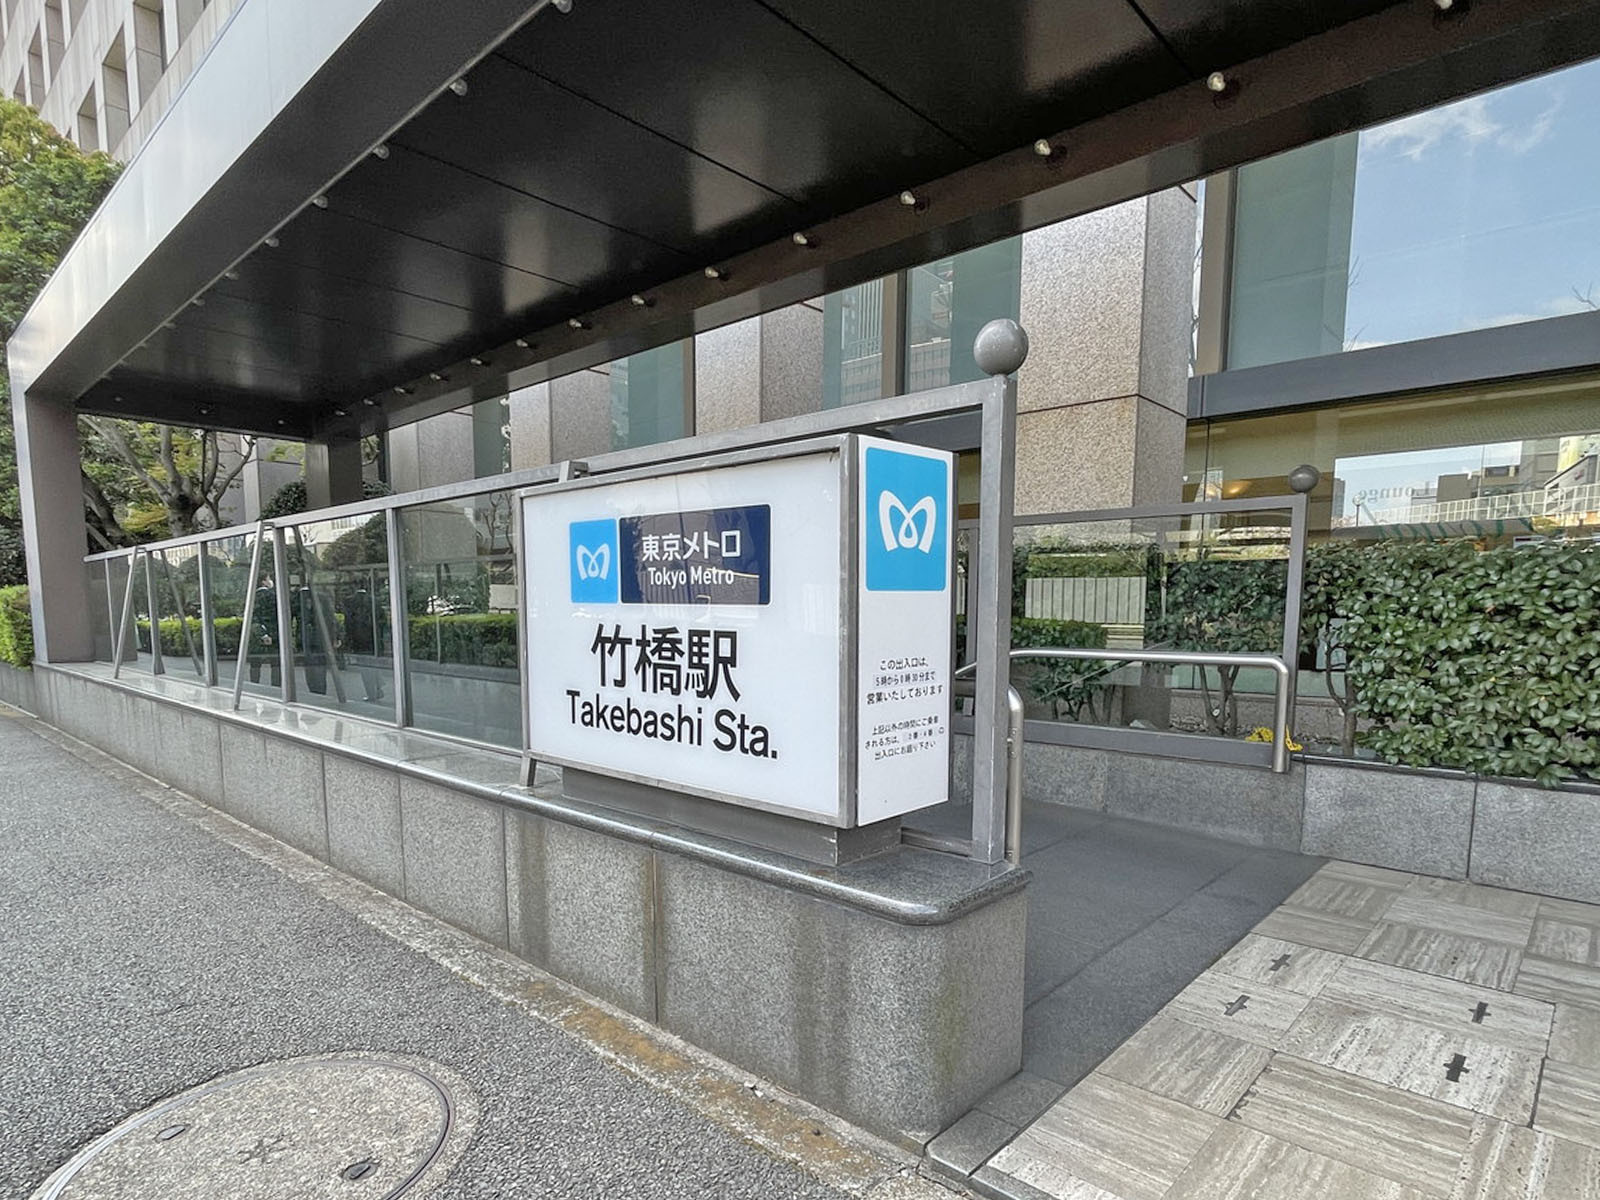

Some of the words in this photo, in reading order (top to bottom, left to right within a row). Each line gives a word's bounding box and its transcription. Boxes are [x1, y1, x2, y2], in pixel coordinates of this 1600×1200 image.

[641, 529, 741, 562] 東京メトロ
[647, 567, 687, 590] Tokyo
[690, 565, 734, 586] Metro
[591, 623, 741, 702] 竹橋駅
[566, 689, 703, 747] Takebashi
[712, 708, 778, 759] Sta.
